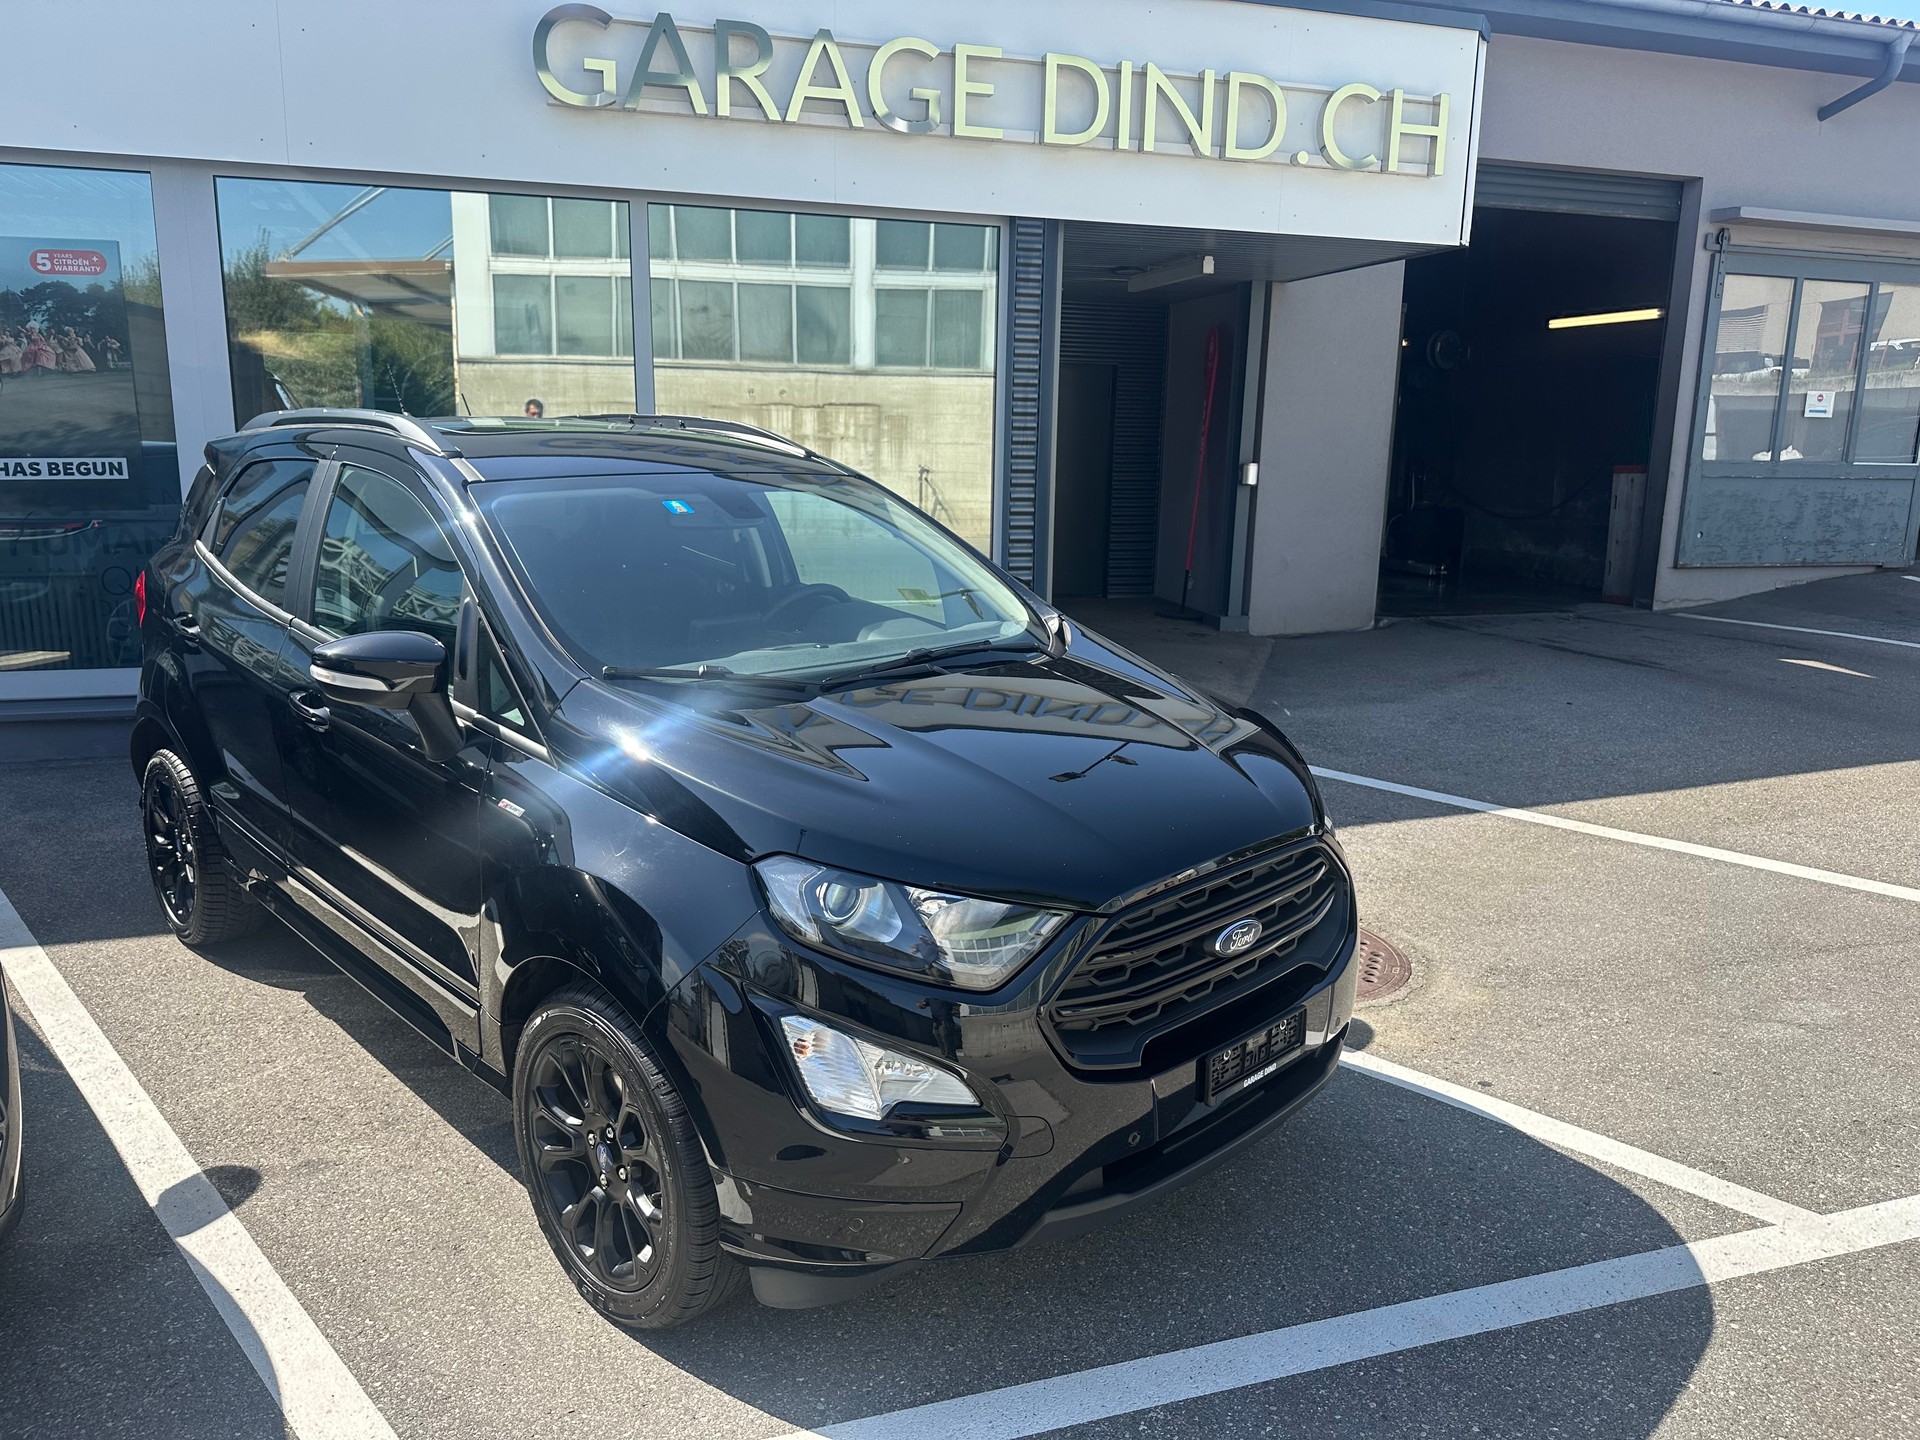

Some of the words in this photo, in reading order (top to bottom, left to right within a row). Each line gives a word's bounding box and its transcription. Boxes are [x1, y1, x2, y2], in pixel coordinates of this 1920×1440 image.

[532, 3, 1004, 139] GARAGE
[1041, 52, 1451, 177] DIND.CH
[36, 252, 52, 271] 5
[53, 258, 90, 266] CITROËN
[47, 461, 124, 477] BEGUN
[1230, 926, 1255, 950] Ford
[1243, 1069, 1264, 1088] GARAGE
